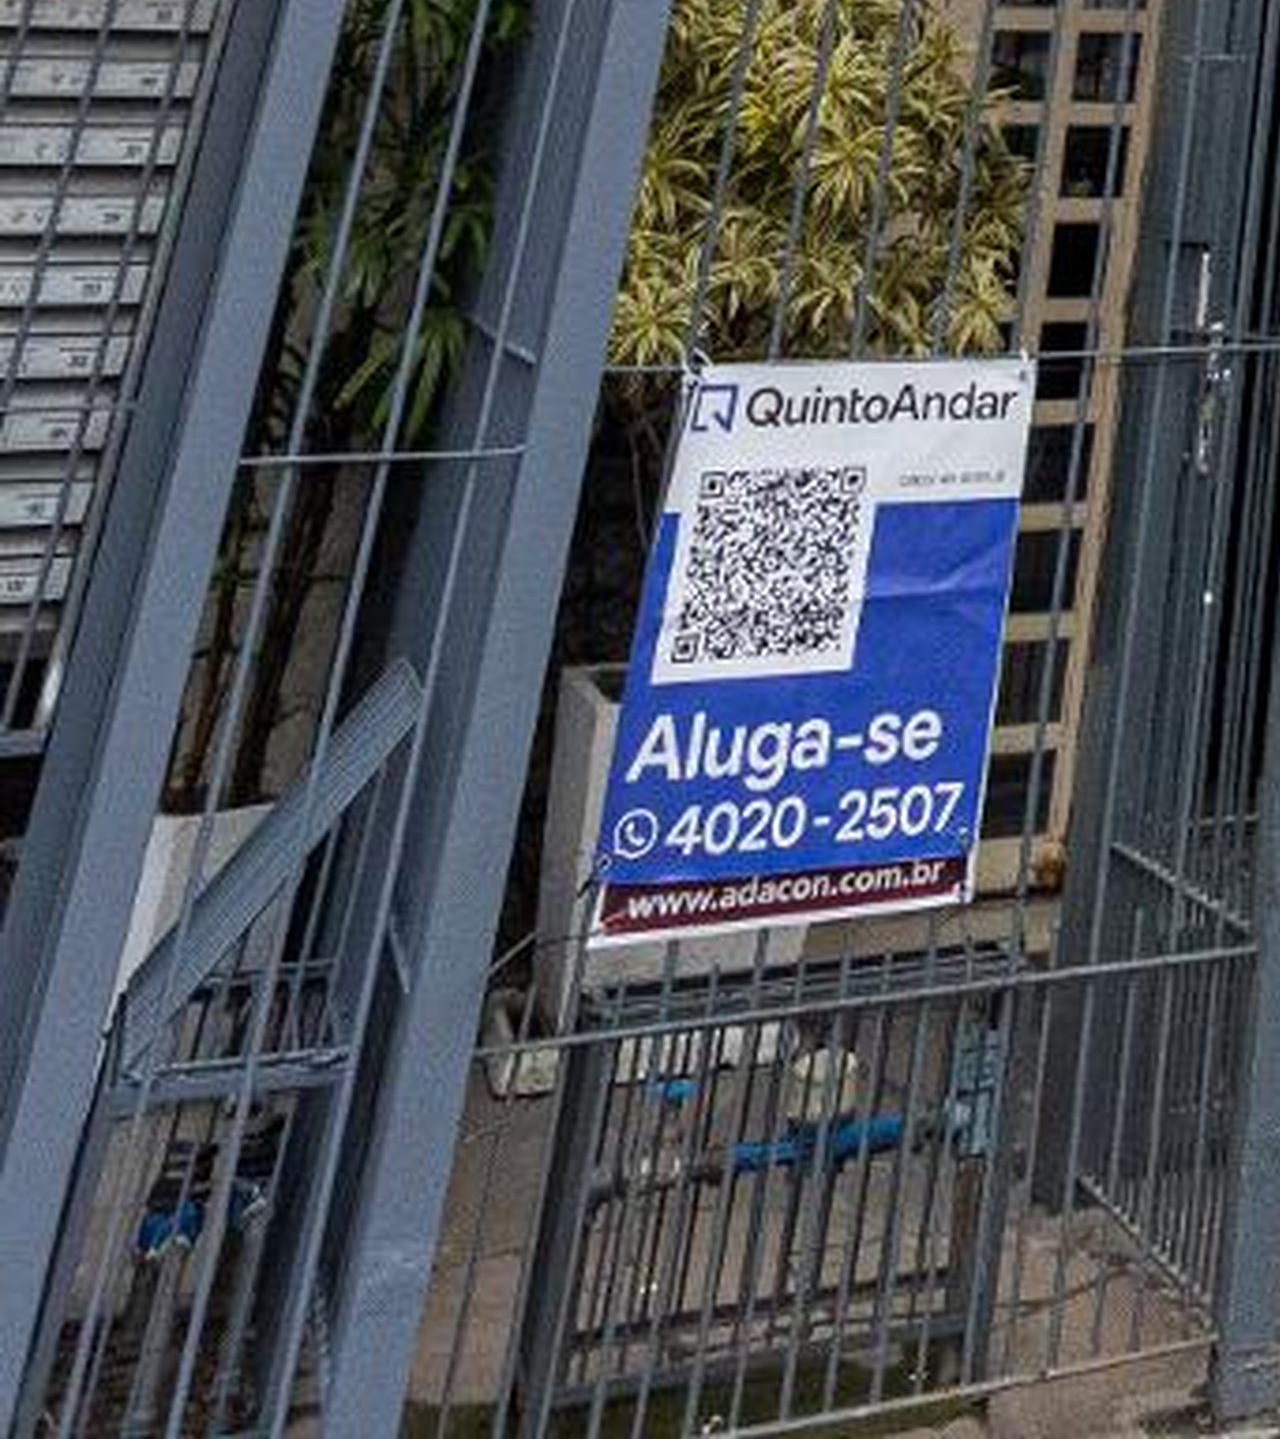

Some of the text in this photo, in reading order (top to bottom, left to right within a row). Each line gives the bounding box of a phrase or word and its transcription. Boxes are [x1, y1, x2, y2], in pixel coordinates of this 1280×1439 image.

[746, 385, 1018, 428] QuintoAndar
[626, 707, 943, 790] Aluga-se
[668, 783, 962, 855] 4020-2507
[626, 861, 946, 920] www.adacon.com.br
